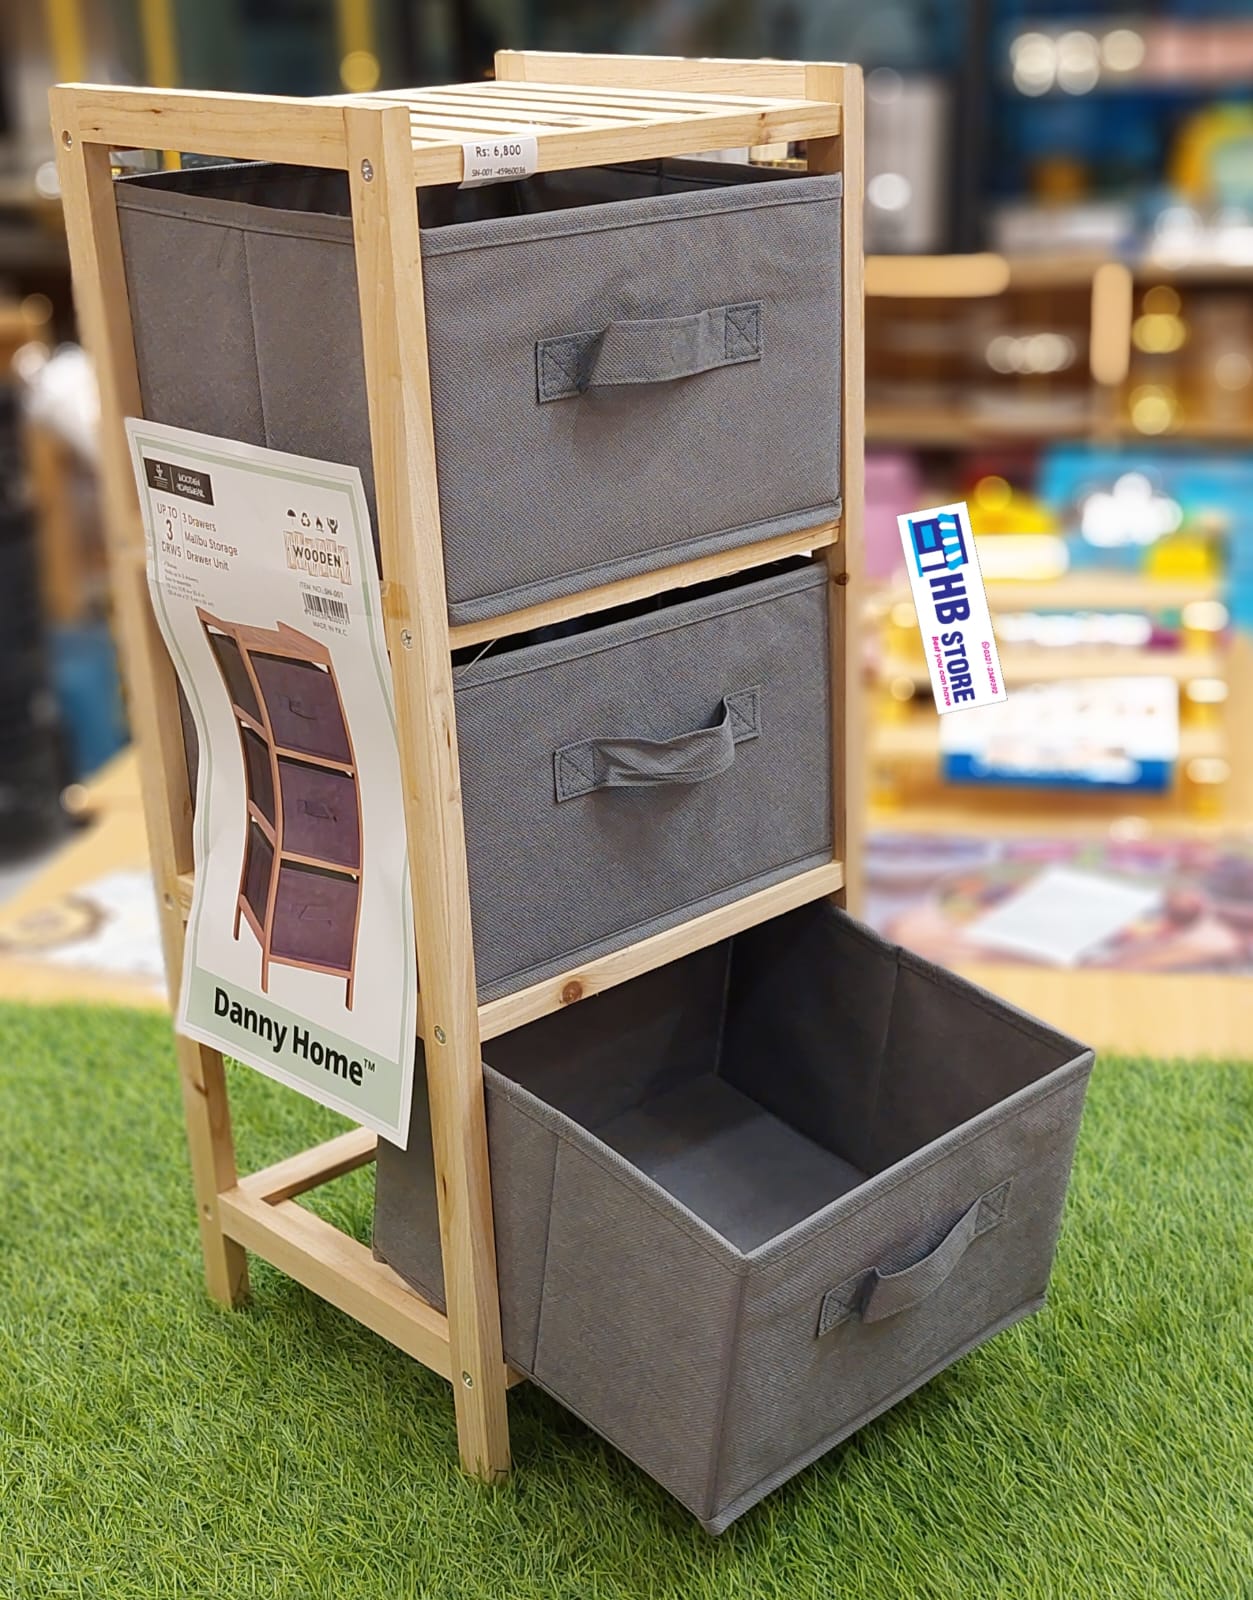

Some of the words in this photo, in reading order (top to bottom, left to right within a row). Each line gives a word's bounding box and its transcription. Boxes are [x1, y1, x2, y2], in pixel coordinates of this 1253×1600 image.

[475, 146, 490, 157] Rs:
[493, 144, 522, 158] 6,800
[156, 502, 167, 515] UP
[167, 505, 178, 519] TO
[165, 518, 174, 541] 3
[187, 514, 217, 532] Drawers
[208, 538, 239, 557] Storage
[293, 544, 342, 569] WOODEN
[186, 550, 212, 567] Drawer
[214, 987, 288, 1053] Danny
